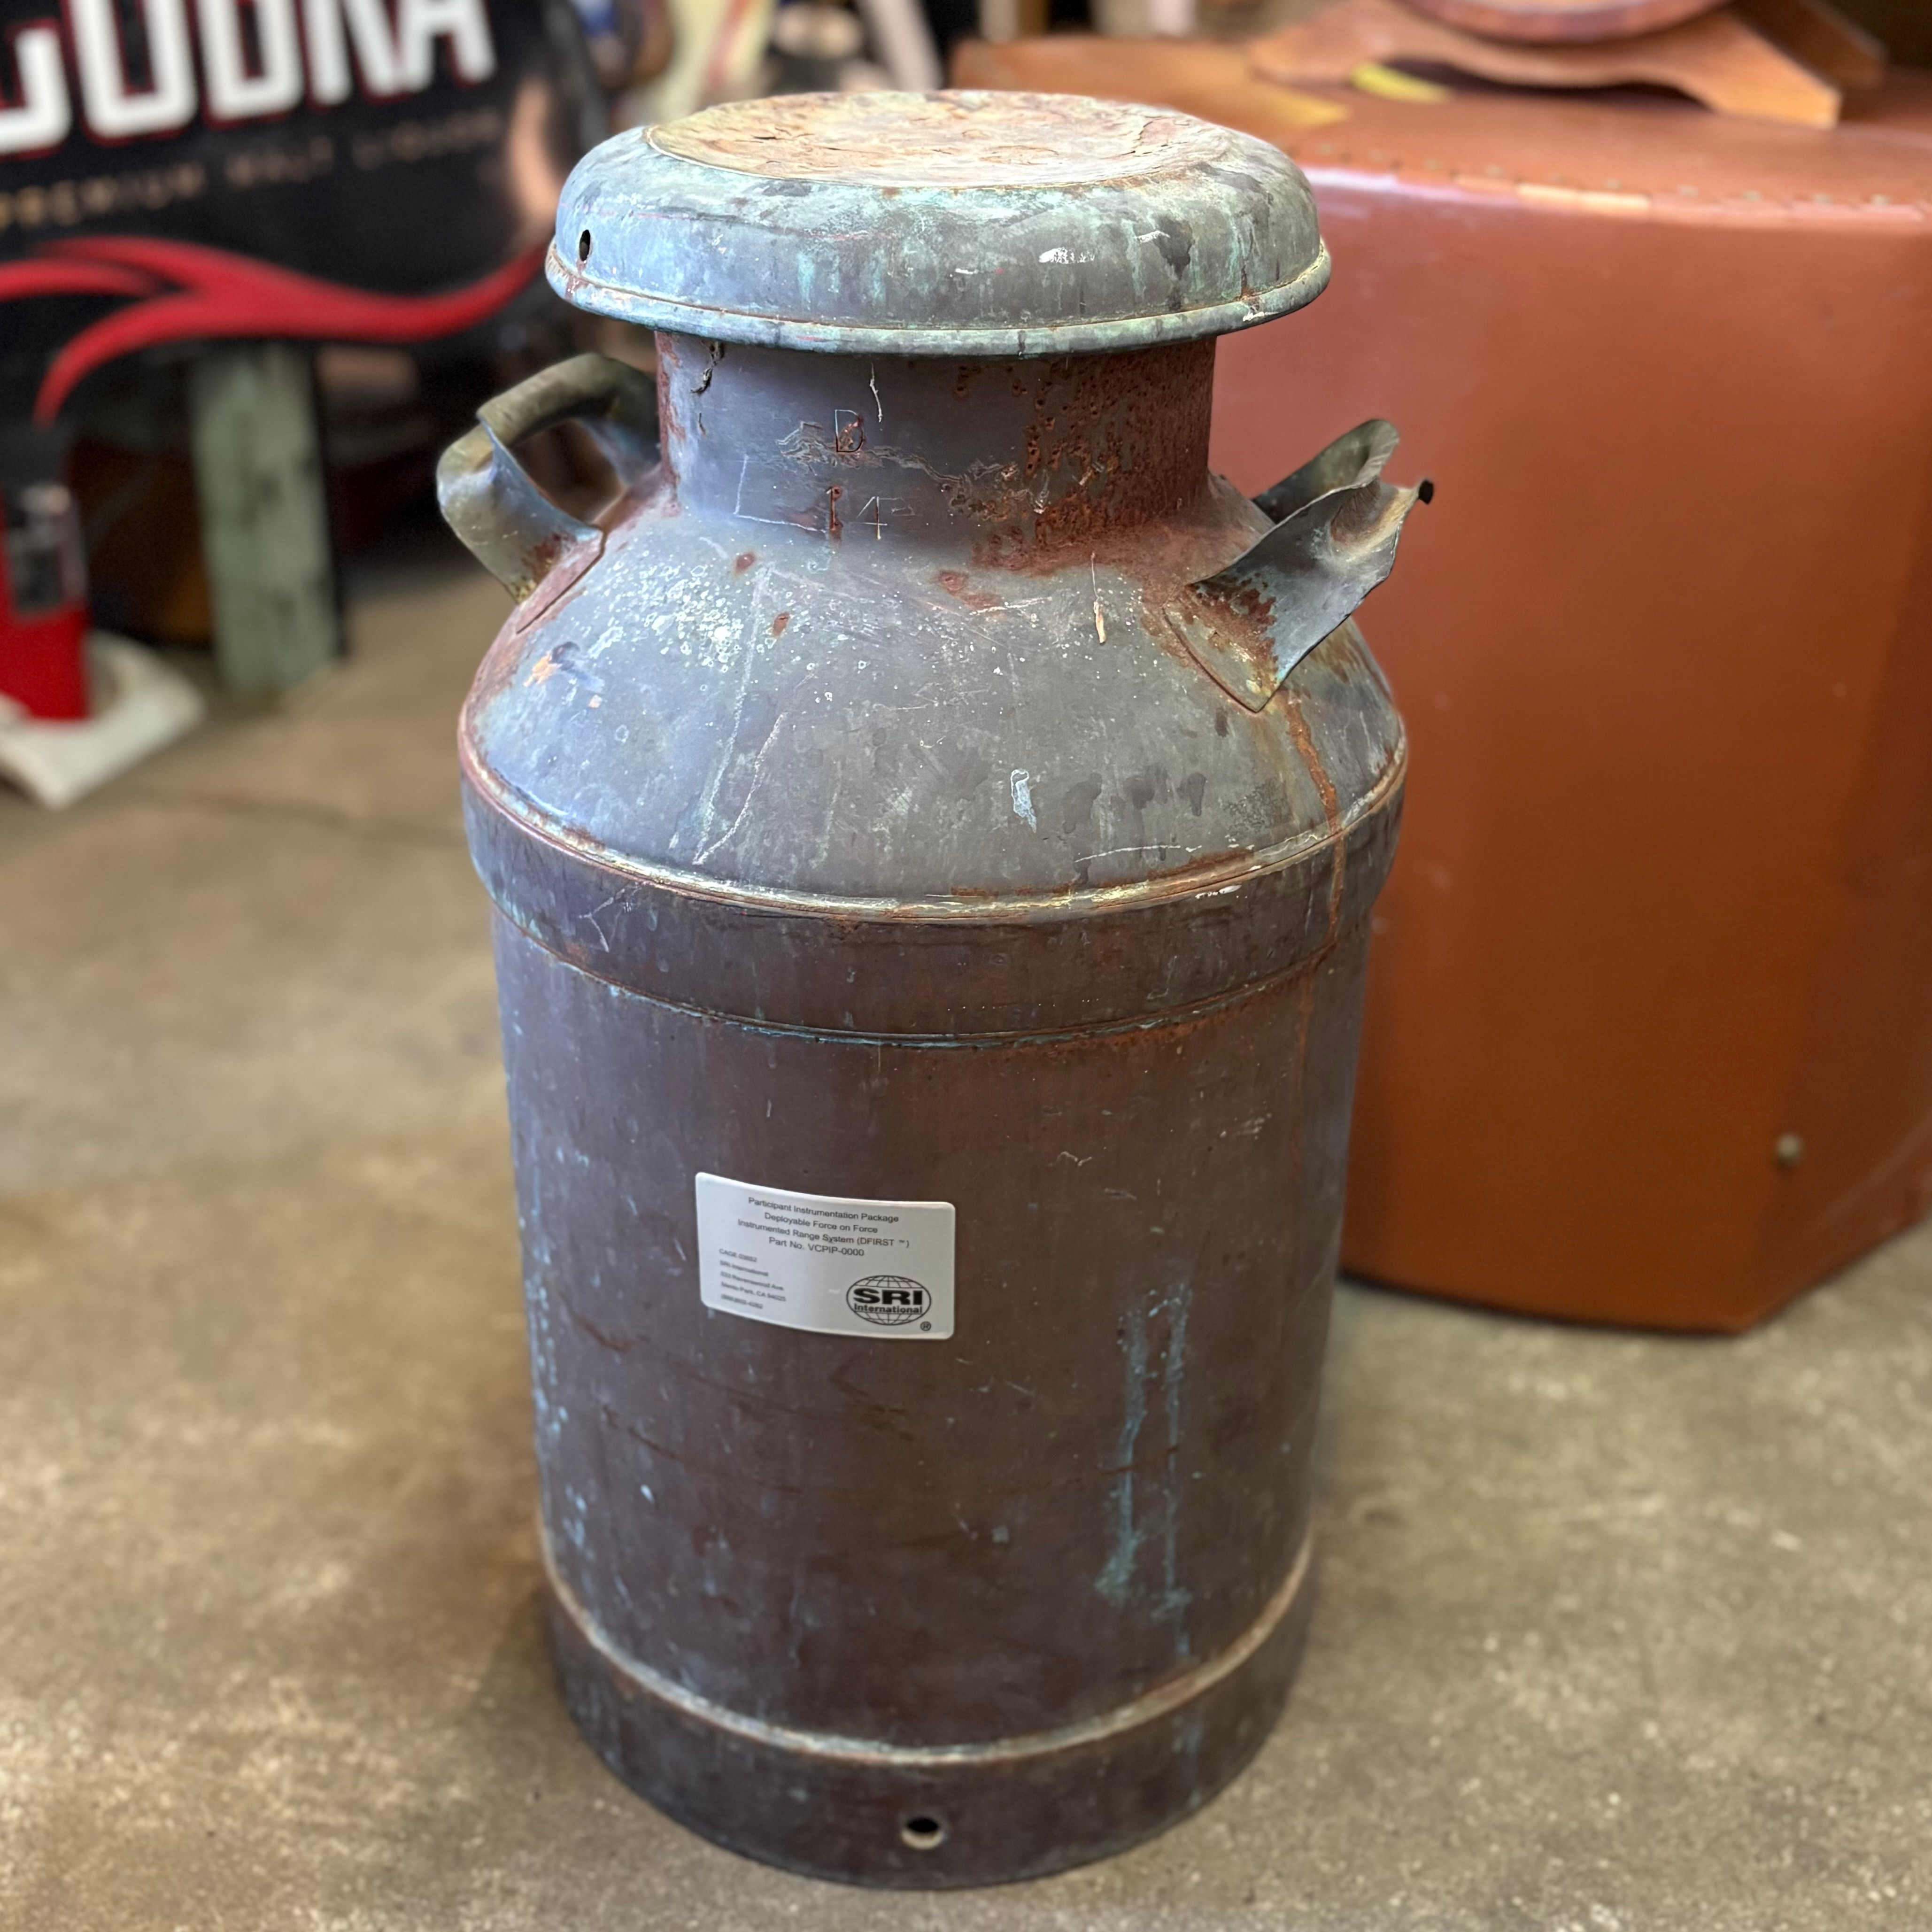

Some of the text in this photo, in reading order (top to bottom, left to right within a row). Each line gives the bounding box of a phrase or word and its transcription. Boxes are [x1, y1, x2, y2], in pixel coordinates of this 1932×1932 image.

[748, 1197, 899, 1223] Participant Instrumentation Package
[765, 1212, 810, 1226] Deployable
[813, 1221, 837, 1229] Force
[738, 1219, 790, 1235] Instrumented
[793, 1229, 819, 1240] Range
[822, 1234, 854, 1244] System
[769, 1236, 864, 1256] Part No. VCPIP-0000
[853, 1288, 923, 1305] SRI
[854, 1303, 922, 1314] International
